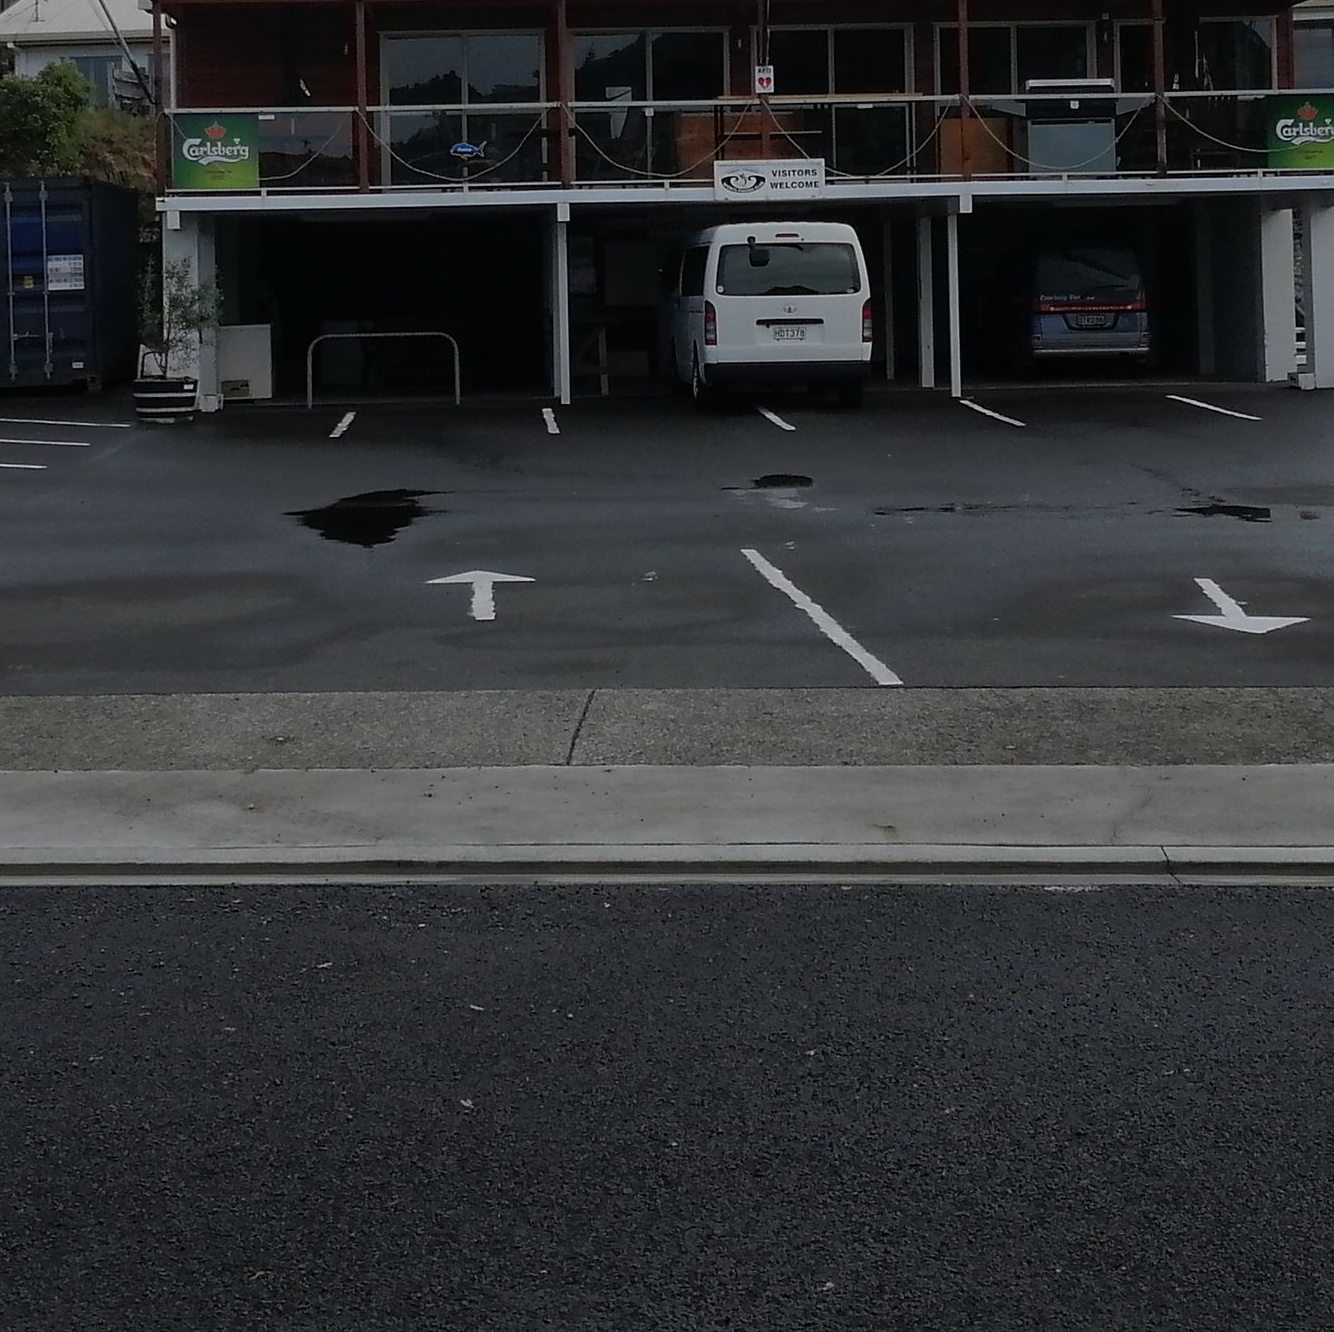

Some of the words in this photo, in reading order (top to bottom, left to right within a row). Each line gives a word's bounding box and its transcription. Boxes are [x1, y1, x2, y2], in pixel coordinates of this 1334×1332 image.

[182, 138, 249, 164] Carlsberg
[771, 169, 818, 177] VISITORS
[770, 181, 820, 189] WELCOME
